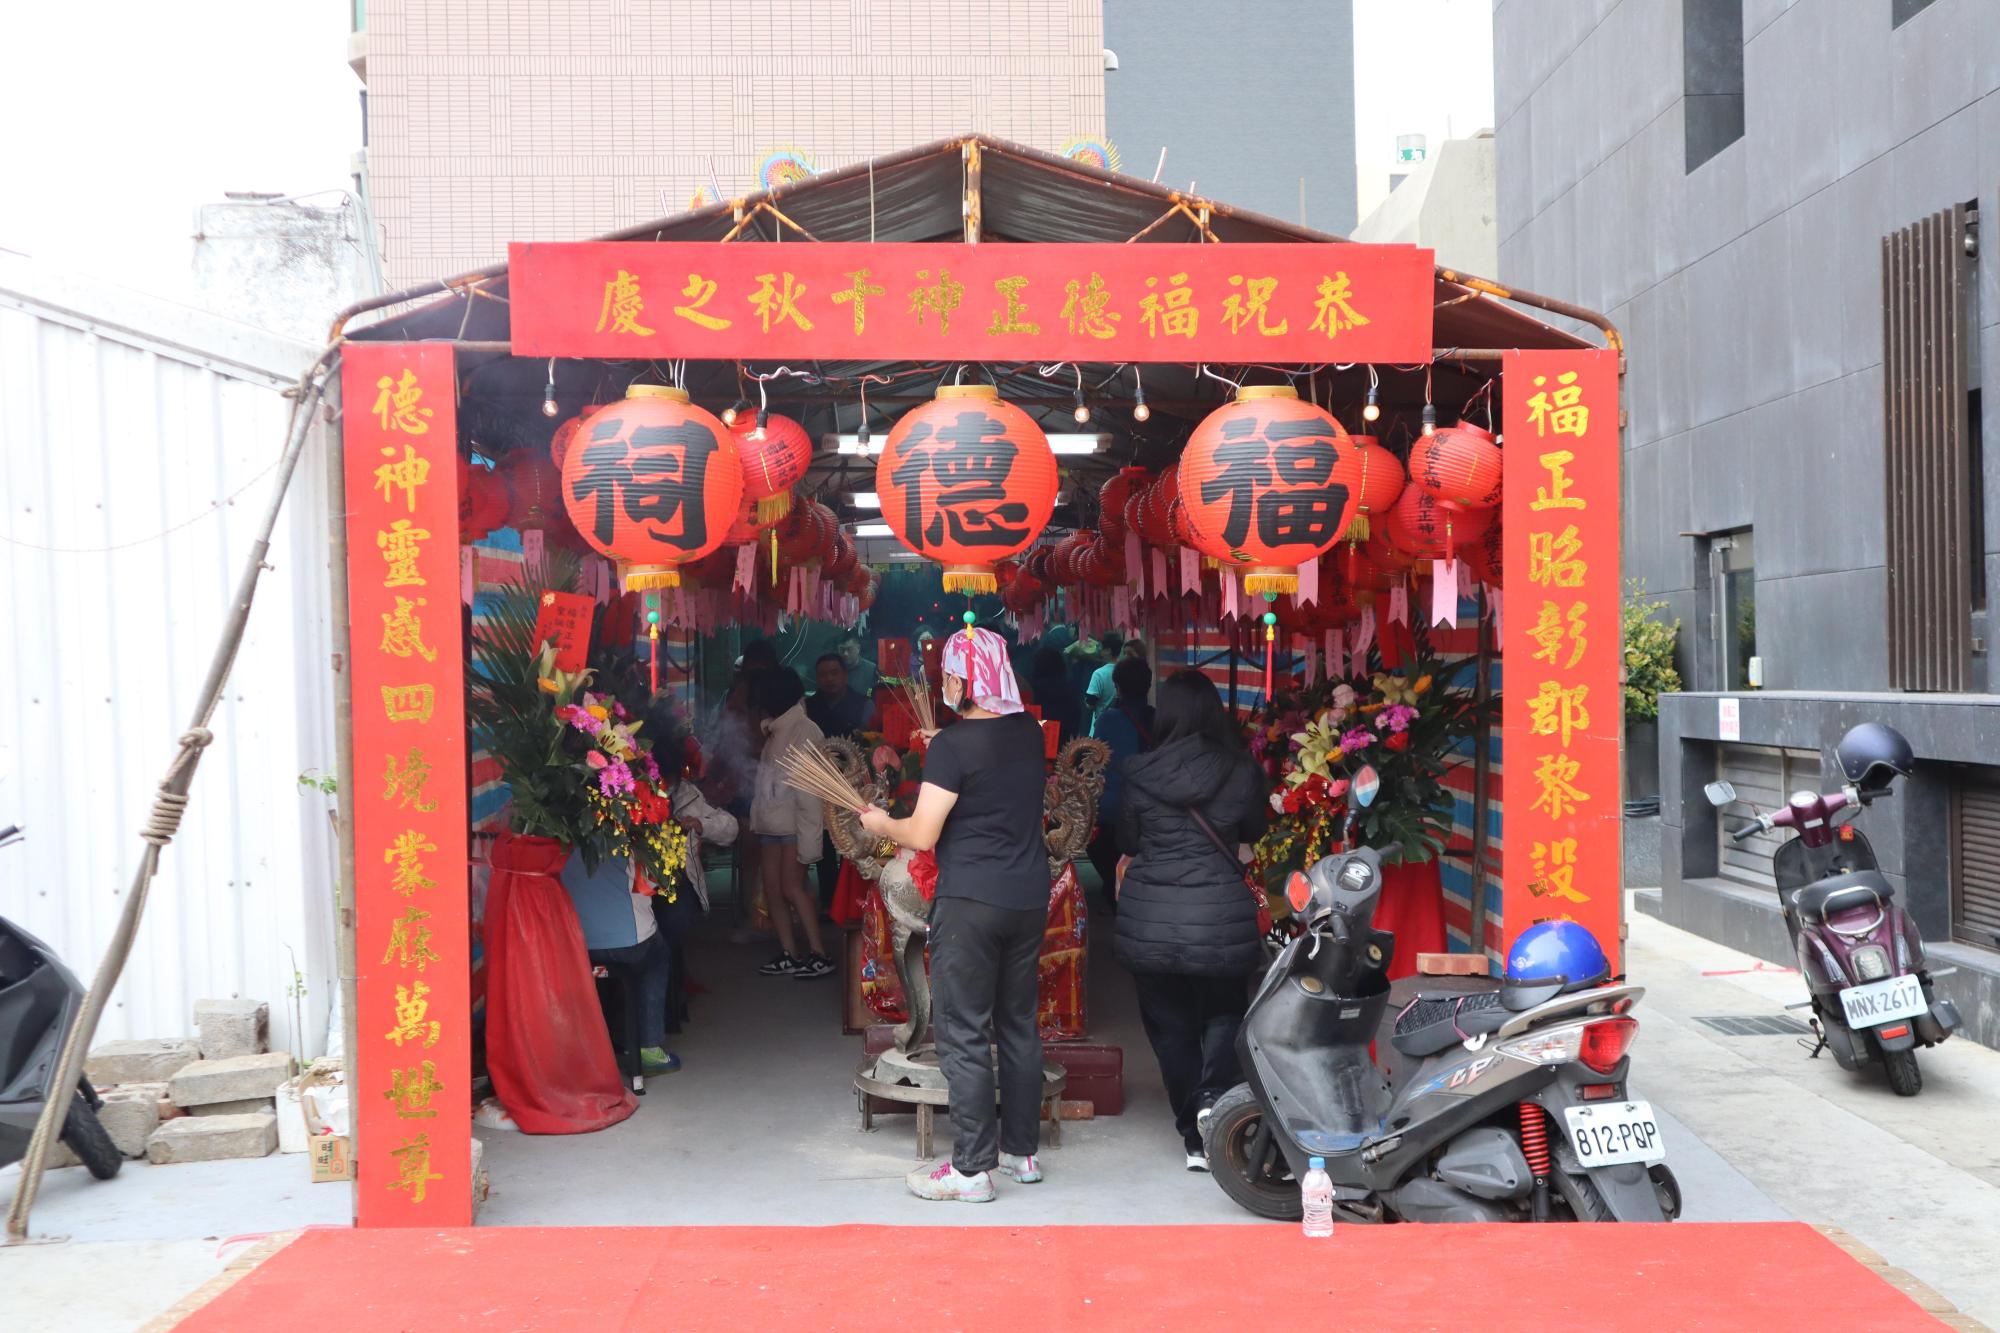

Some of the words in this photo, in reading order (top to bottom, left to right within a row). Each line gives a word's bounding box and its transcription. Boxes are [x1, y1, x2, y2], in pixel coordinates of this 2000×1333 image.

[571, 418, 719, 550] 祠
[891, 412, 1031, 551] 德
[1201, 416, 1349, 549] 福
[1526, 371, 1592, 923] 福正昭彰郡黎設
